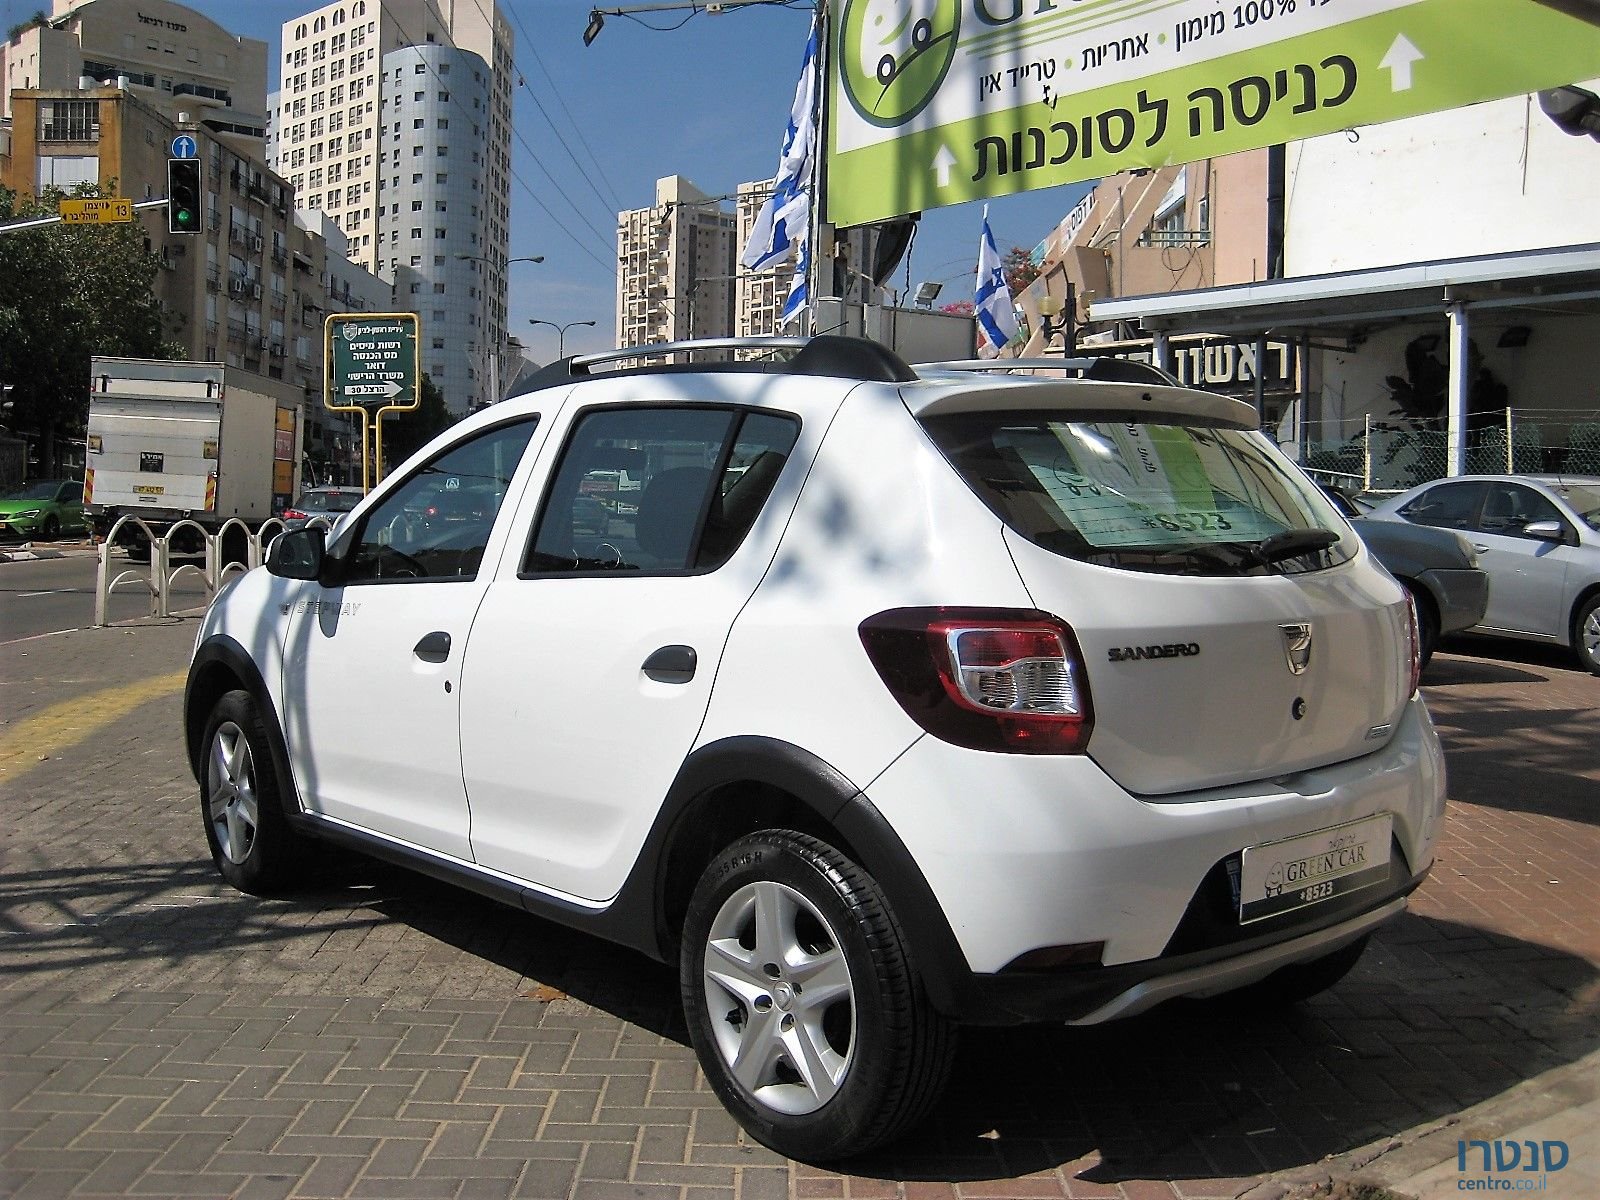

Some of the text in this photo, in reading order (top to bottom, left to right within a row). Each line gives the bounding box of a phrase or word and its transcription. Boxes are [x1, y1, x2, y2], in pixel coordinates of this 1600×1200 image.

[137, 12, 163, 27] דניאל
[980, 0, 1297, 101] 100% מימון אחריות טרייד אין
[972, 55, 1357, 182] כניסה לסוכנות
[85, 202, 104, 211] ויצמן
[115, 205, 127, 216] 13
[350, 342, 401, 351] רשות מיסים
[353, 352, 381, 361] הכנסה
[365, 362, 386, 370] דואר
[377, 372, 404, 380] משרד
[351, 386, 361, 394] 30
[1107, 642, 1200, 662] SANDERO
[1287, 845, 1367, 882] GREEN CAR
